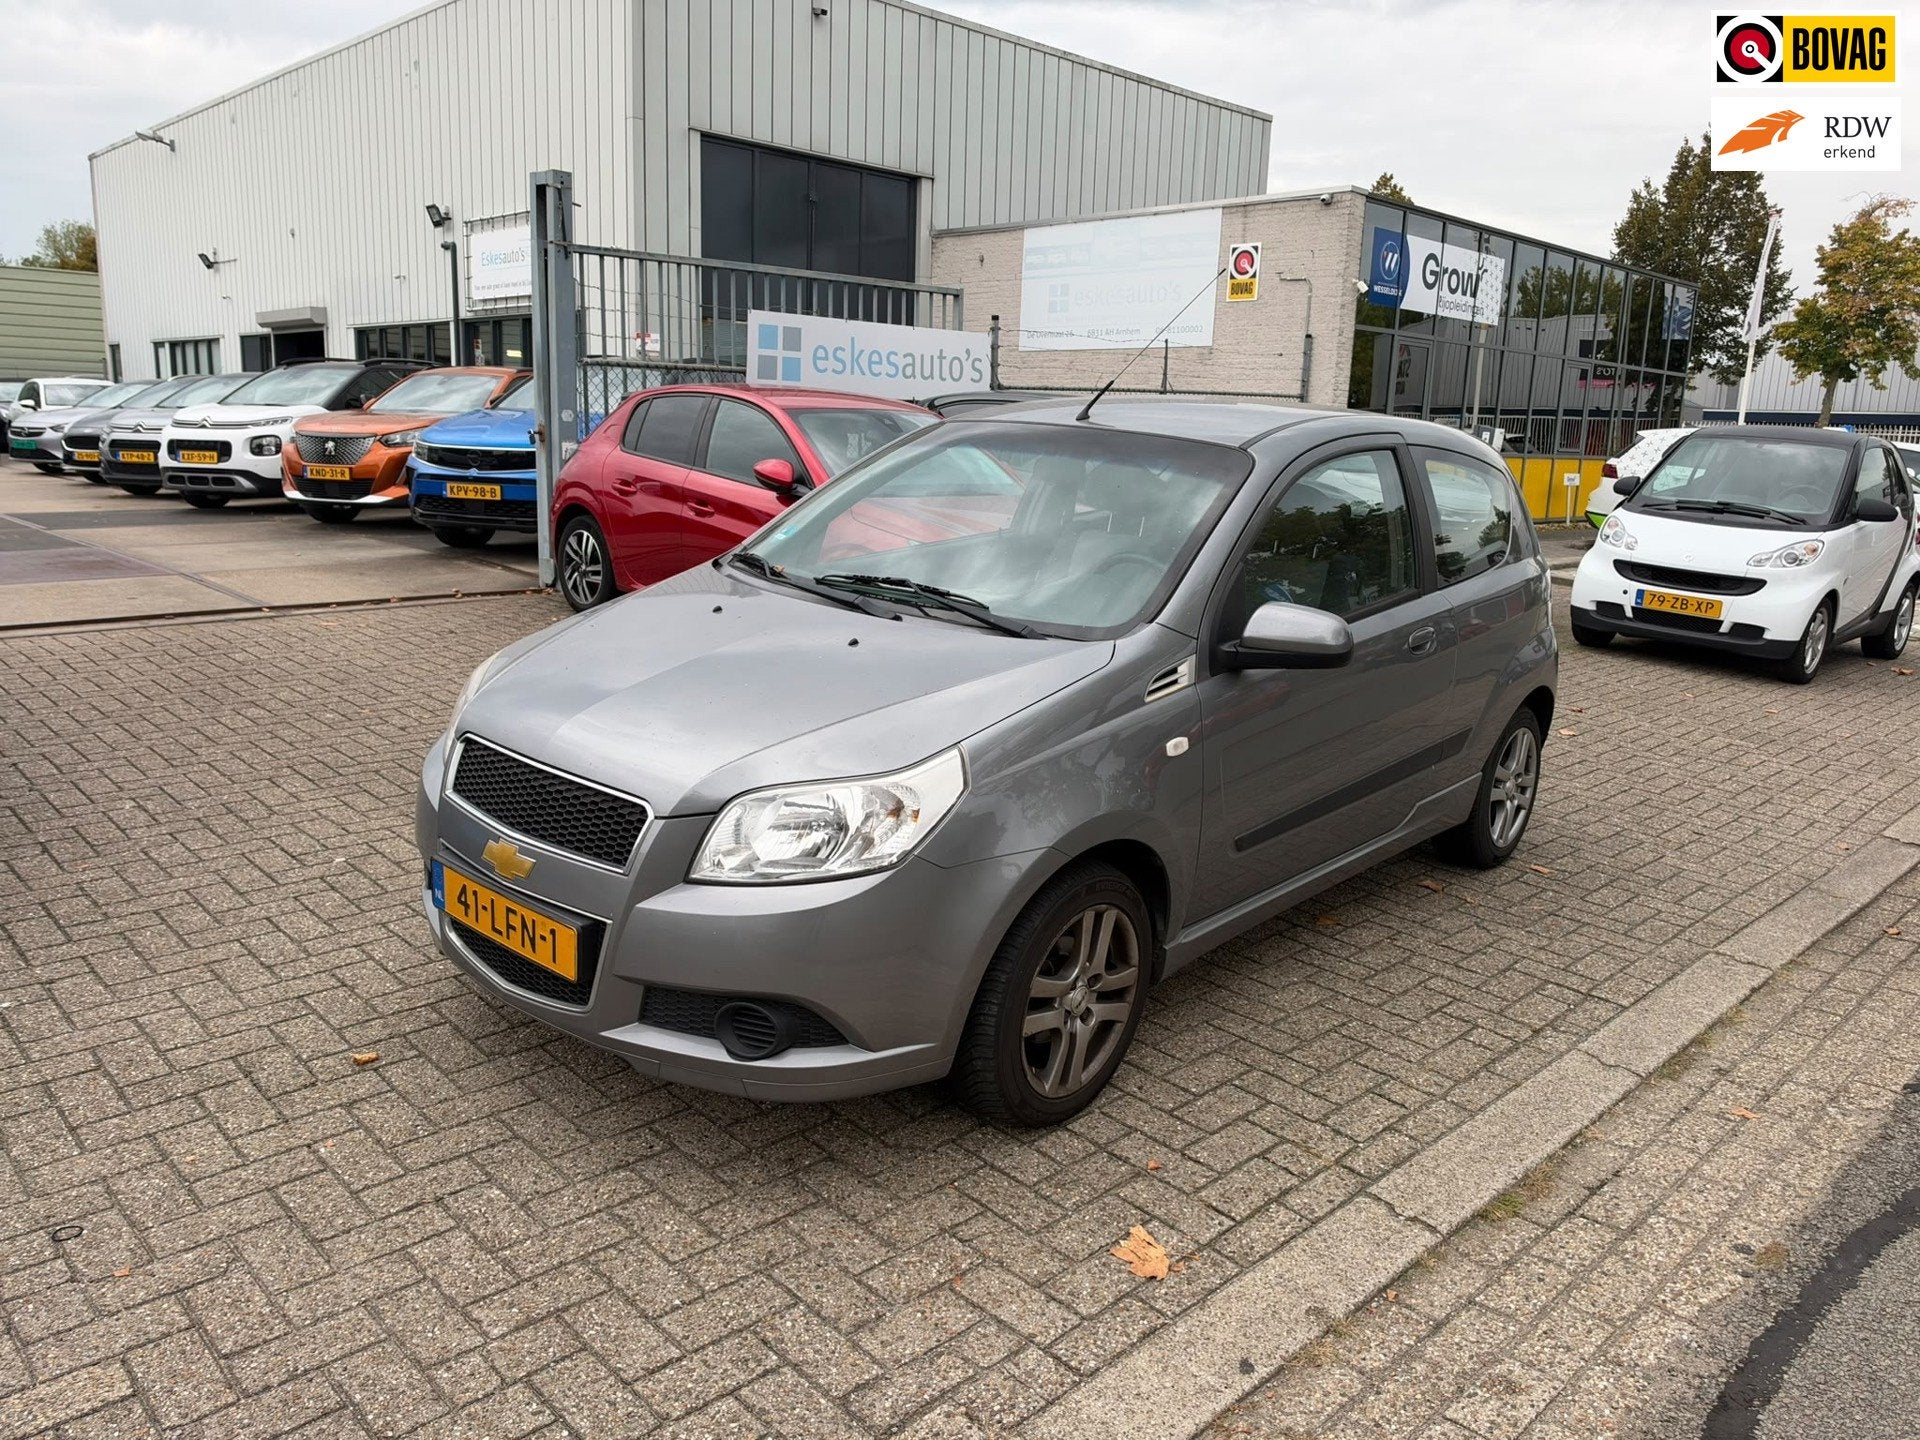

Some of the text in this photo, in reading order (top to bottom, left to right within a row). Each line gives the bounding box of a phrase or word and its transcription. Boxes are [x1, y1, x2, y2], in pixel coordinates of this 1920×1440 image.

[481, 247, 526, 267] Eskesauto's
[1422, 252, 1481, 299] Grow
[1230, 281, 1254, 296] BOVAG
[812, 336, 984, 383] eskesauto's
[309, 466, 347, 479] KND-31-R
[450, 483, 497, 498] KPV-98-B
[1649, 593, 1715, 614] 79-ZB-XP
[457, 883, 557, 965] 41-LFN-1
